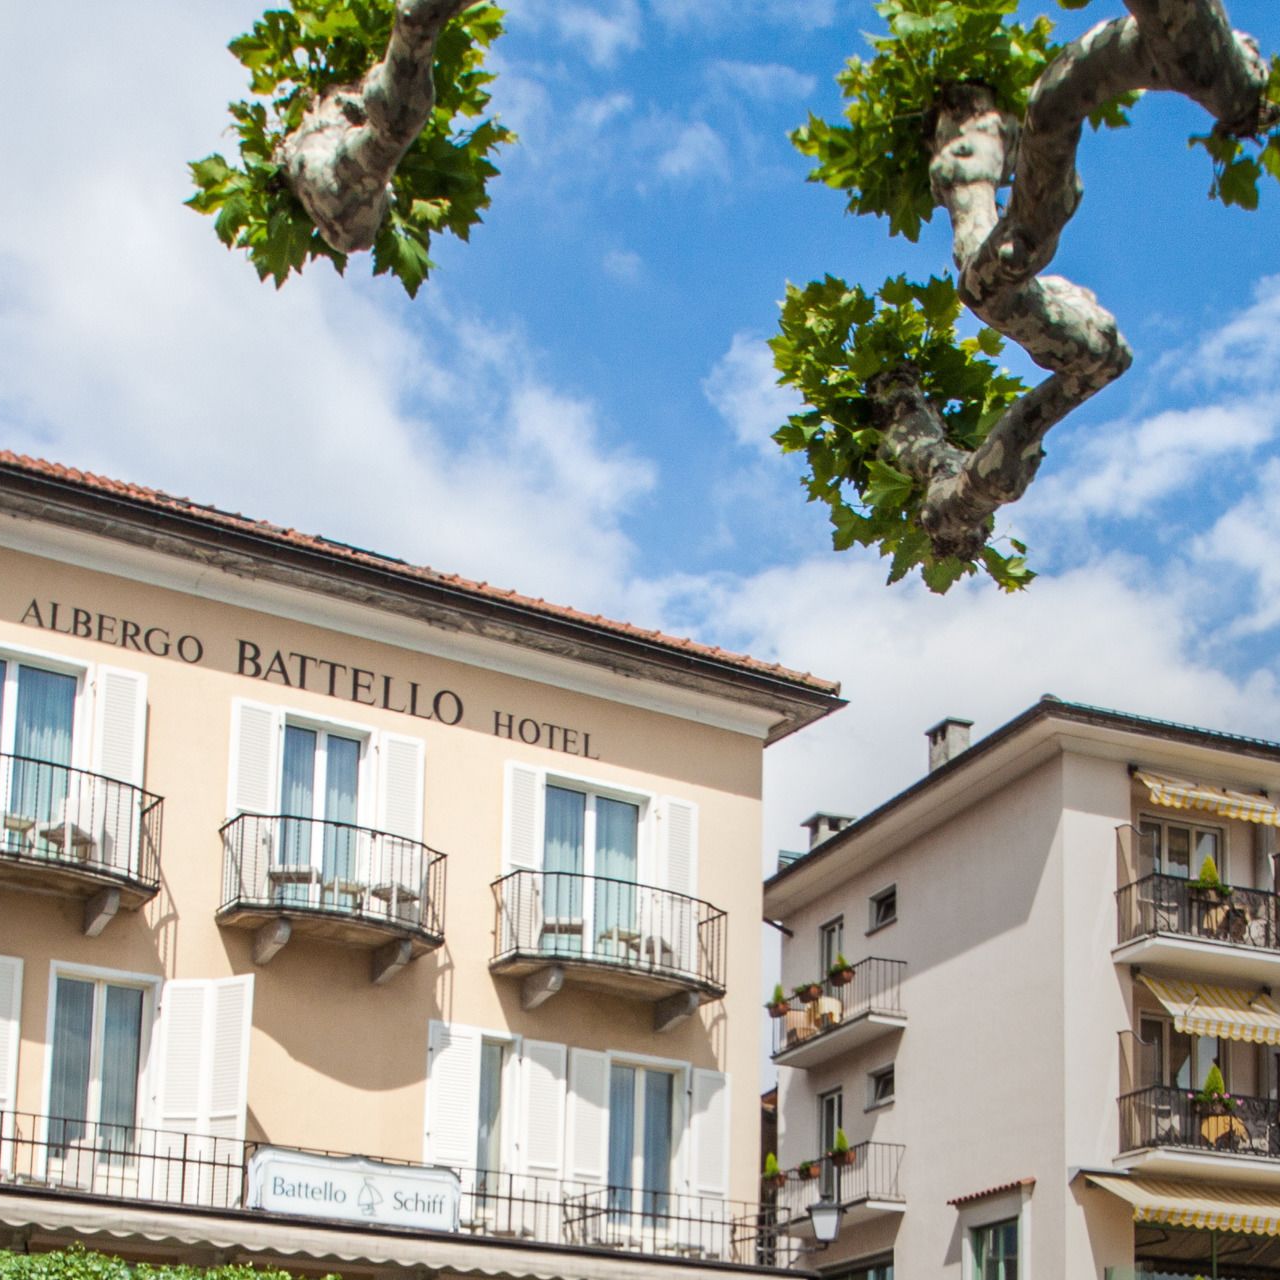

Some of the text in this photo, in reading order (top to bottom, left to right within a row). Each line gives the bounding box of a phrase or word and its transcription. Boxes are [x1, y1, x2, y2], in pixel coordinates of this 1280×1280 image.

[20, 598, 601, 760] ALBERGO BATTELLO HOTEL
[272, 1175, 446, 1215] Battello Schiff
